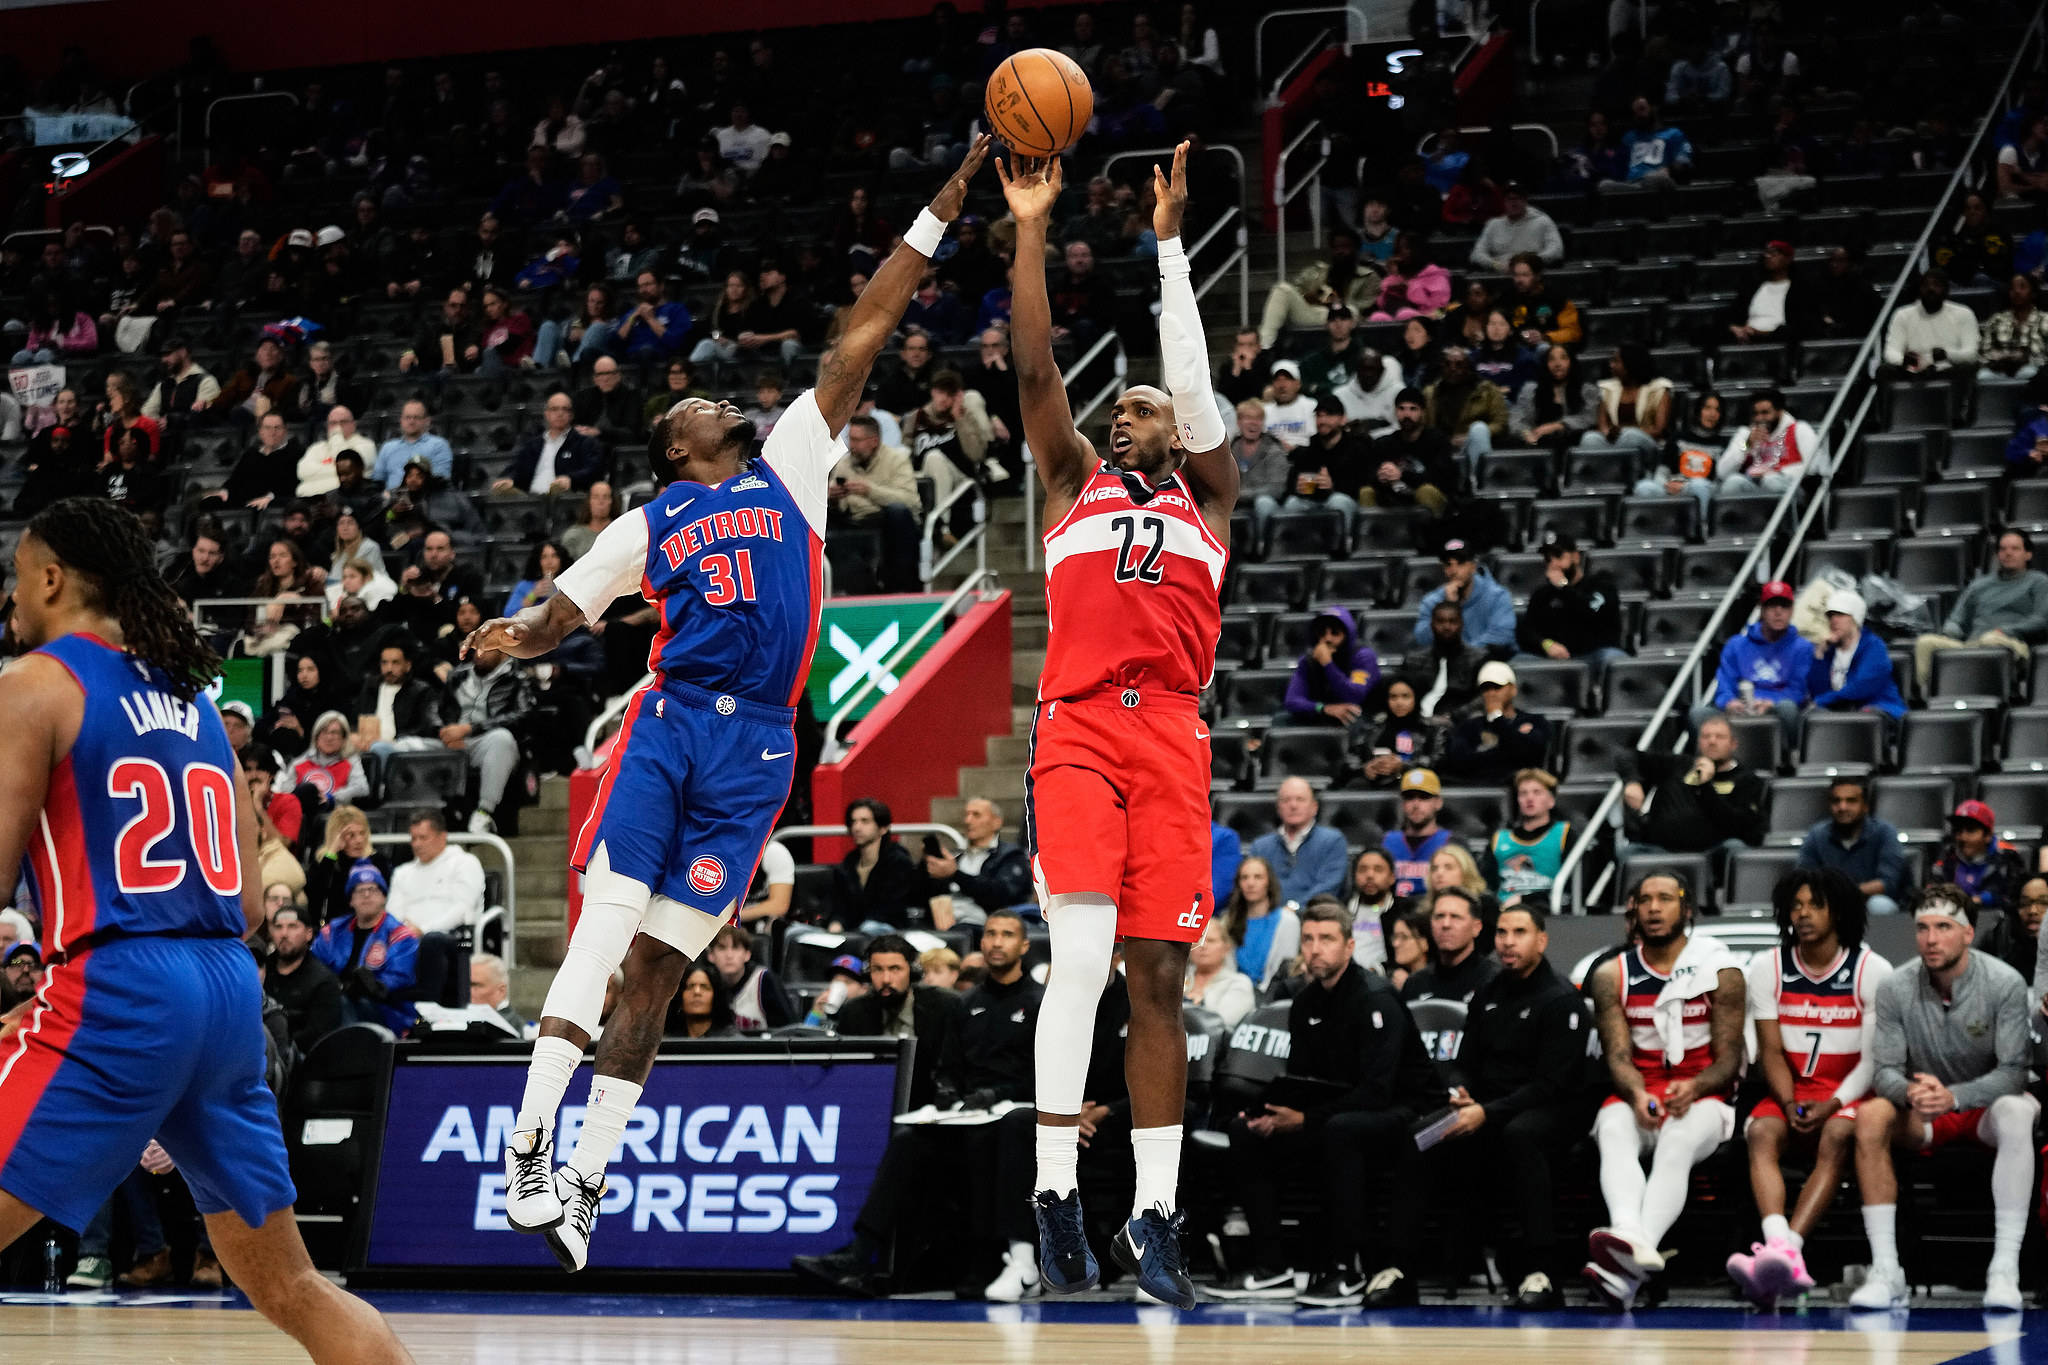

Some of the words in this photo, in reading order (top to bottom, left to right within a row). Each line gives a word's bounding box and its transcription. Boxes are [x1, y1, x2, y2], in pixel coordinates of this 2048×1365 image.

[660, 507, 783, 572] DETROIT
[1111, 515, 1165, 584] 22
[700, 549, 757, 606] 31
[119, 690, 199, 741] LANIER
[107, 756, 242, 896] 20
[1177, 900, 1204, 928] dc
[1230, 1023, 1268, 1053] GET
[1264, 1028, 1292, 1059] TH
[1801, 1030, 1823, 1078] 7
[474, 1173, 841, 1233] EPRESS
